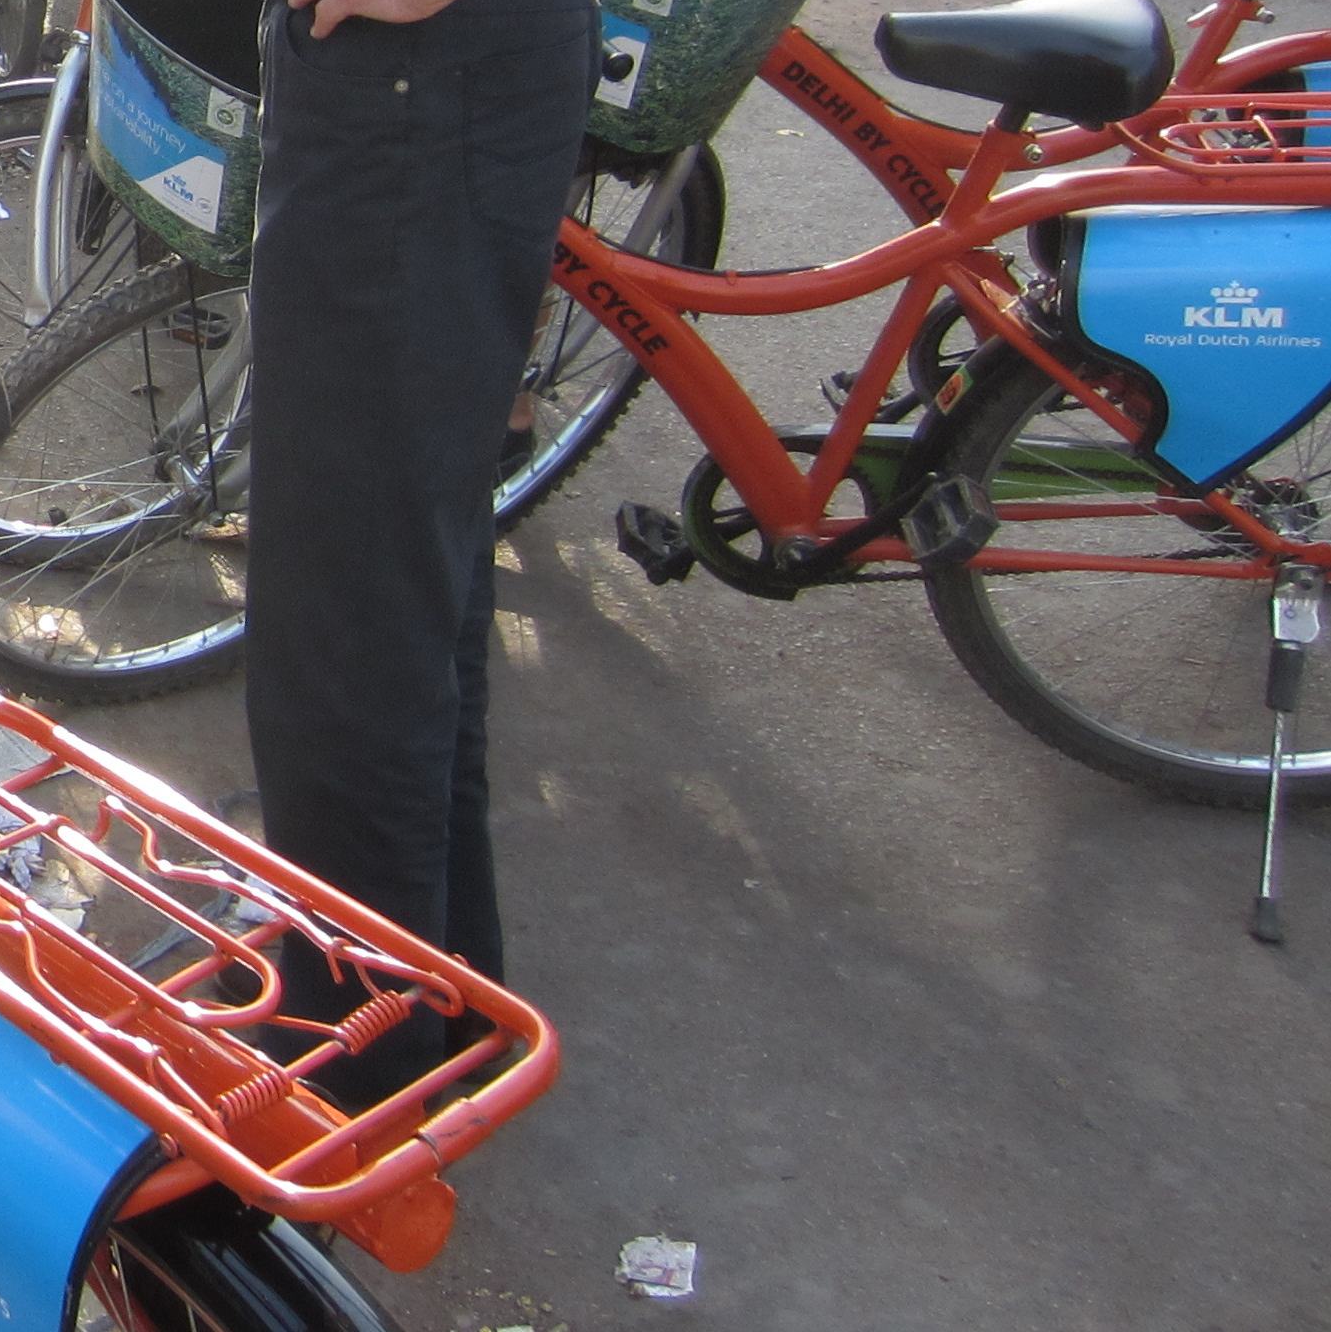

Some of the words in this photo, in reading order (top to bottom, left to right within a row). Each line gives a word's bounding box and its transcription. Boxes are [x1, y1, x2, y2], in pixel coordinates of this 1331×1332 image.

[781, 60, 859, 124] DELHI
[853, 121, 891, 151] BY
[587, 280, 669, 357] CYCLE
[1143, 333, 1193, 347] Royal
[1197, 333, 1250, 346] Dutch
[1255, 334, 1323, 348] Airlines
[1183, 306, 1284, 329] KLM
